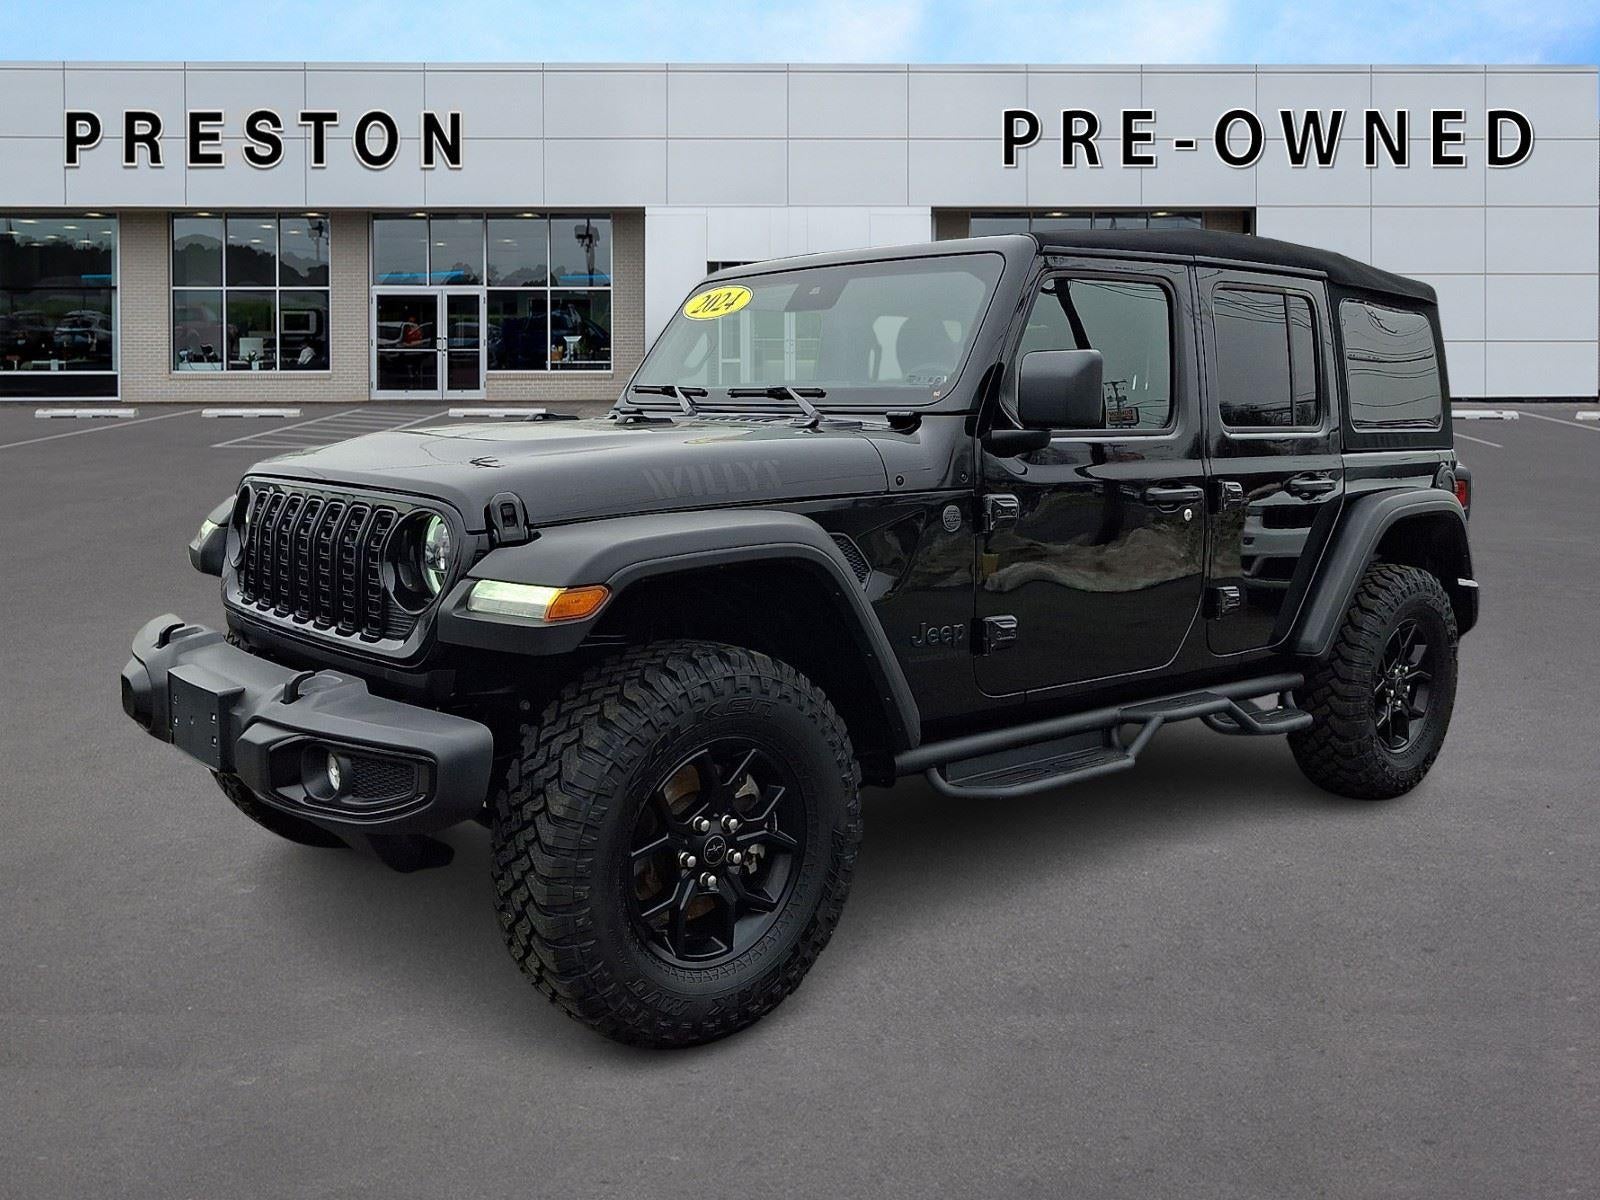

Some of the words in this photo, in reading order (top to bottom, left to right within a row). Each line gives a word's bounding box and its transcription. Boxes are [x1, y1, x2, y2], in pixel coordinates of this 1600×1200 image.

[65, 109, 461, 167] PRESTON
[1003, 108, 1533, 167] PRE-OWNED
[690, 290, 745, 314] 2024
[641, 459, 783, 497] WILLYS
[911, 620, 965, 647] Jeep
